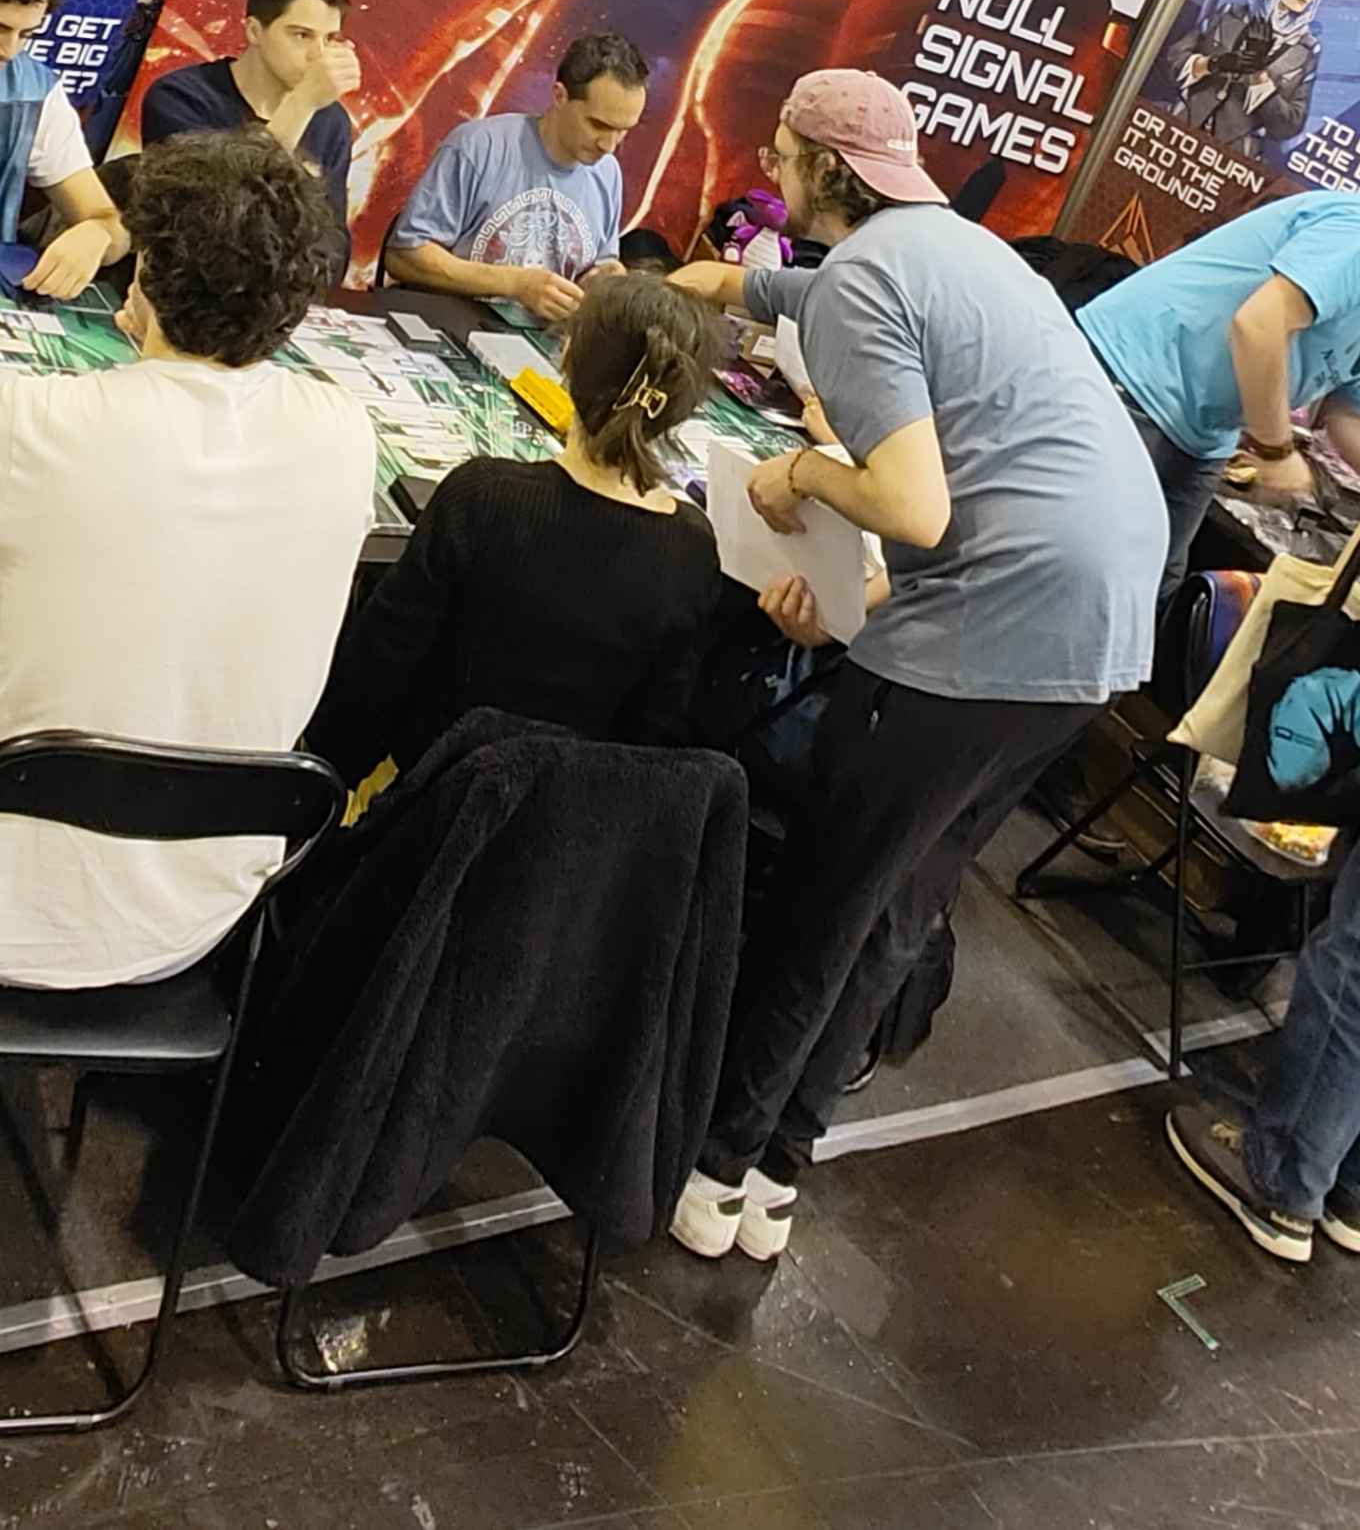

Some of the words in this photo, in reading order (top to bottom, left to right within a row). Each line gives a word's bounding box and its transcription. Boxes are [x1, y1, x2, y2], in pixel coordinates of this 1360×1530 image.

[56, 15, 120, 40] GET
[56, 41, 109, 66] BIG
[915, 24, 1097, 124] SIGNAL
[901, 83, 1077, 175] GAMES
[1122, 126, 1146, 148] IT
[1149, 138, 1177, 168] TO
[1180, 158, 1225, 197] THE
[1132, 107, 1166, 138] OR
[1169, 126, 1200, 155] TO
[1198, 145, 1265, 194] BURN
[1305, 133, 1354, 169] THE
[1321, 116, 1354, 147] TO
[1113, 146, 1217, 214] GROUND?
